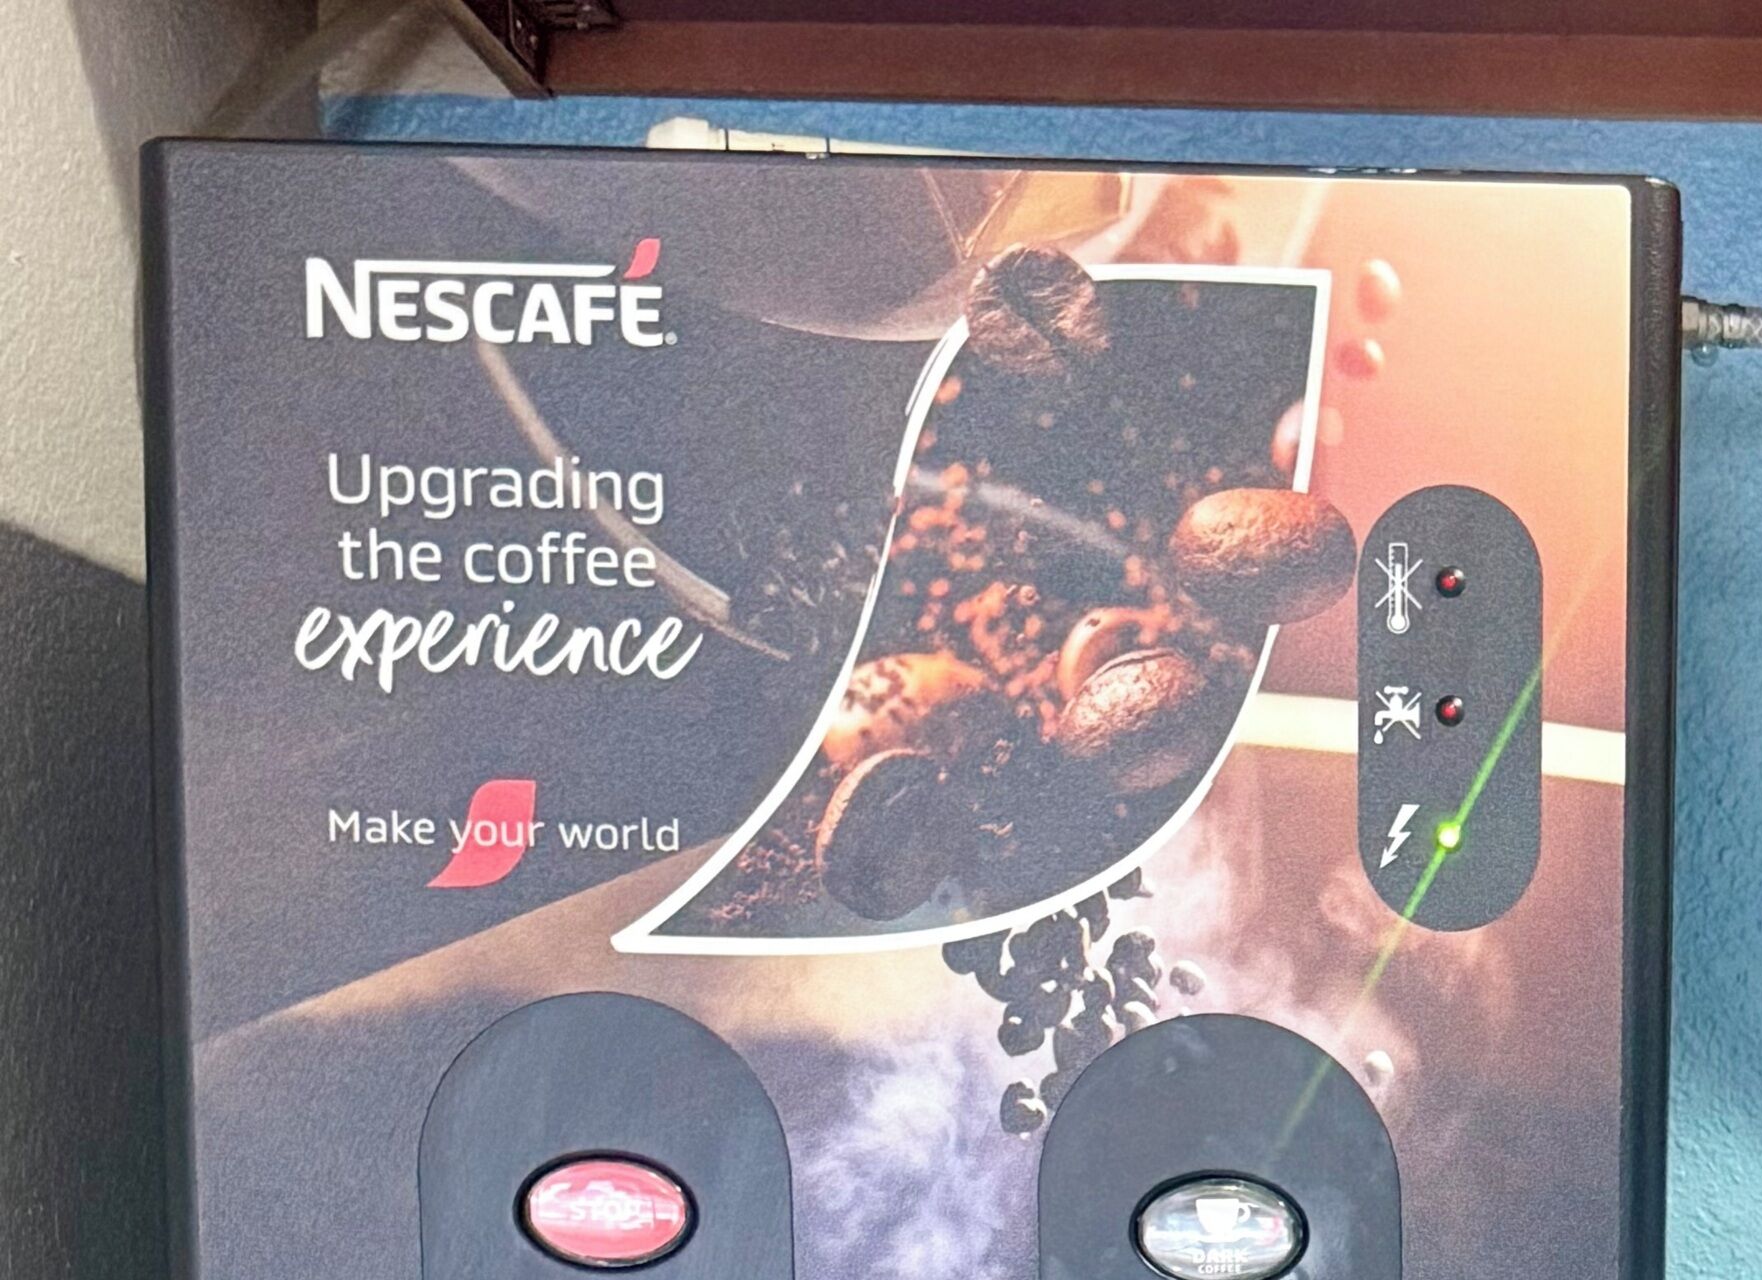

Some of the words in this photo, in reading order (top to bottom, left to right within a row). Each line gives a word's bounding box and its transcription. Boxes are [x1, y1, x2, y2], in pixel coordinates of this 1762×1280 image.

[306, 238, 664, 347] NESCAFÉ
[328, 453, 664, 525] Upgrading
[338, 528, 443, 581] the
[465, 532, 657, 588] coffee
[295, 600, 703, 693] experience
[328, 810, 435, 844] Make
[449, 818, 545, 853] your
[558, 816, 680, 852] world
